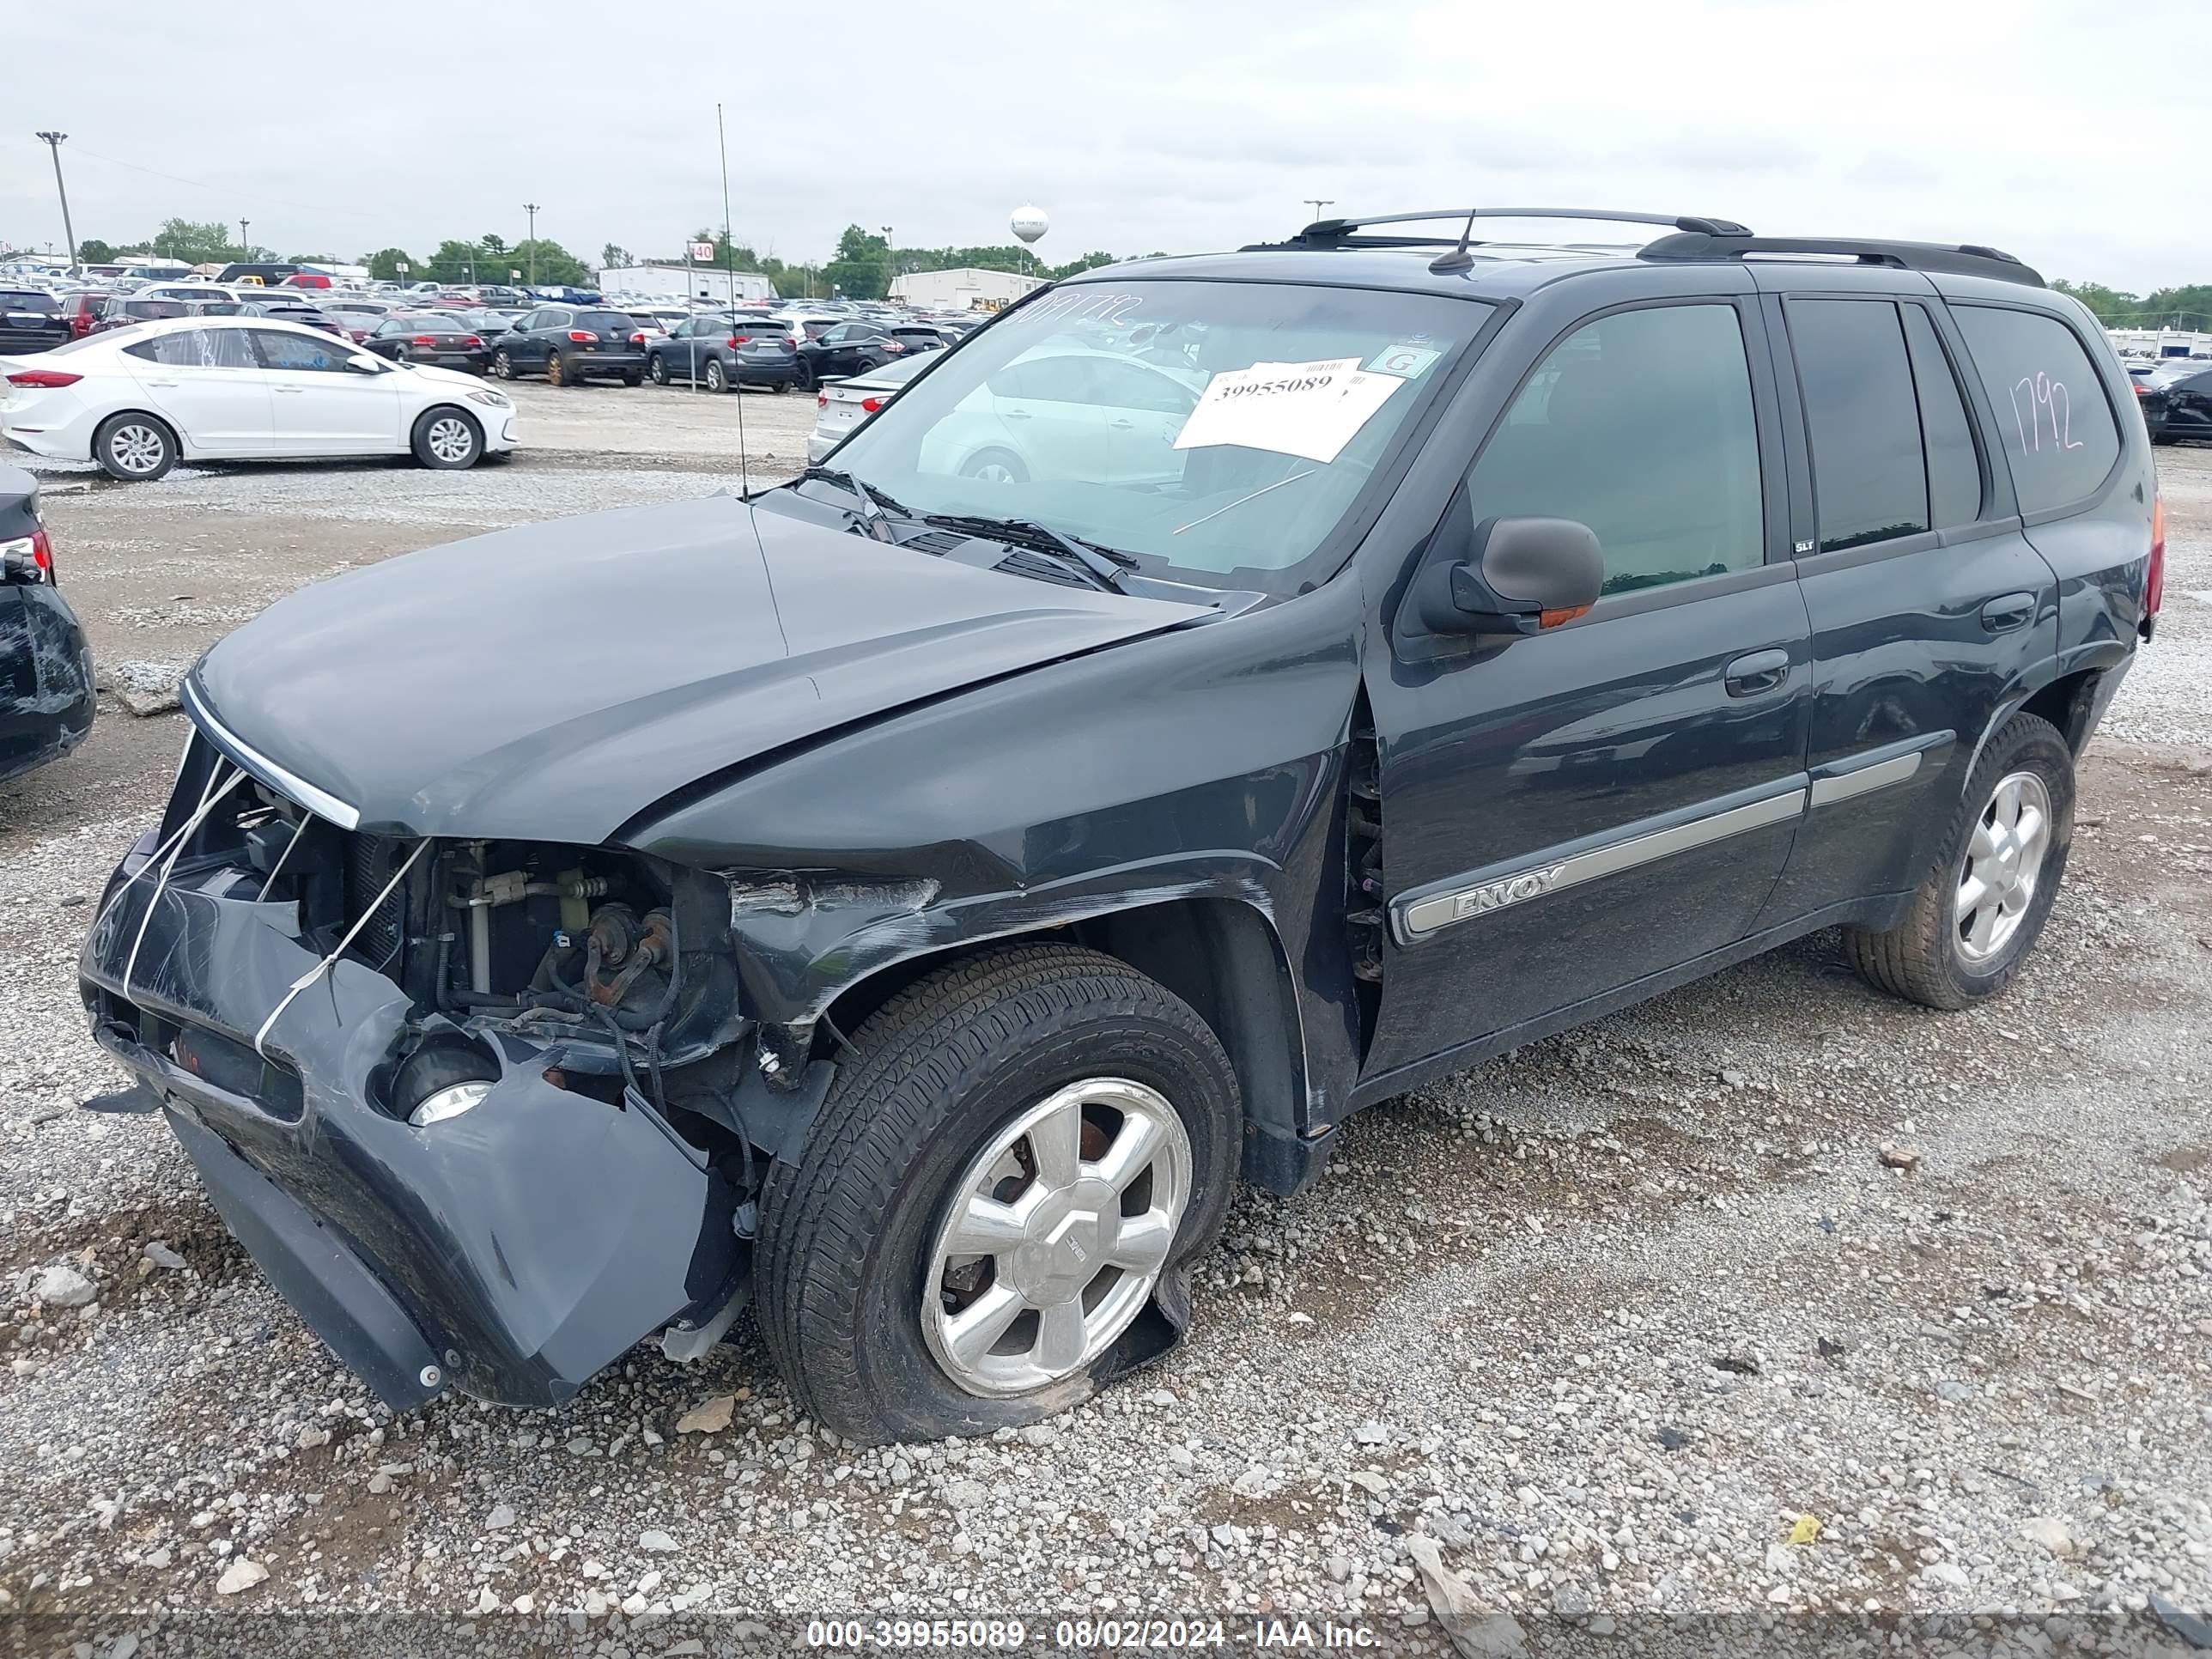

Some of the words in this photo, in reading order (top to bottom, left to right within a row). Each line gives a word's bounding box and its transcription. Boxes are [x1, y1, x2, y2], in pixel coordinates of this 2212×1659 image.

[696, 246, 712, 258] 40
[1385, 353, 1418, 371] G
[1214, 375, 1333, 401] 39955089
[2008, 371, 2084, 456] 1792
[1796, 541, 1814, 553] SLT
[1452, 865, 1566, 921] ENVOY
